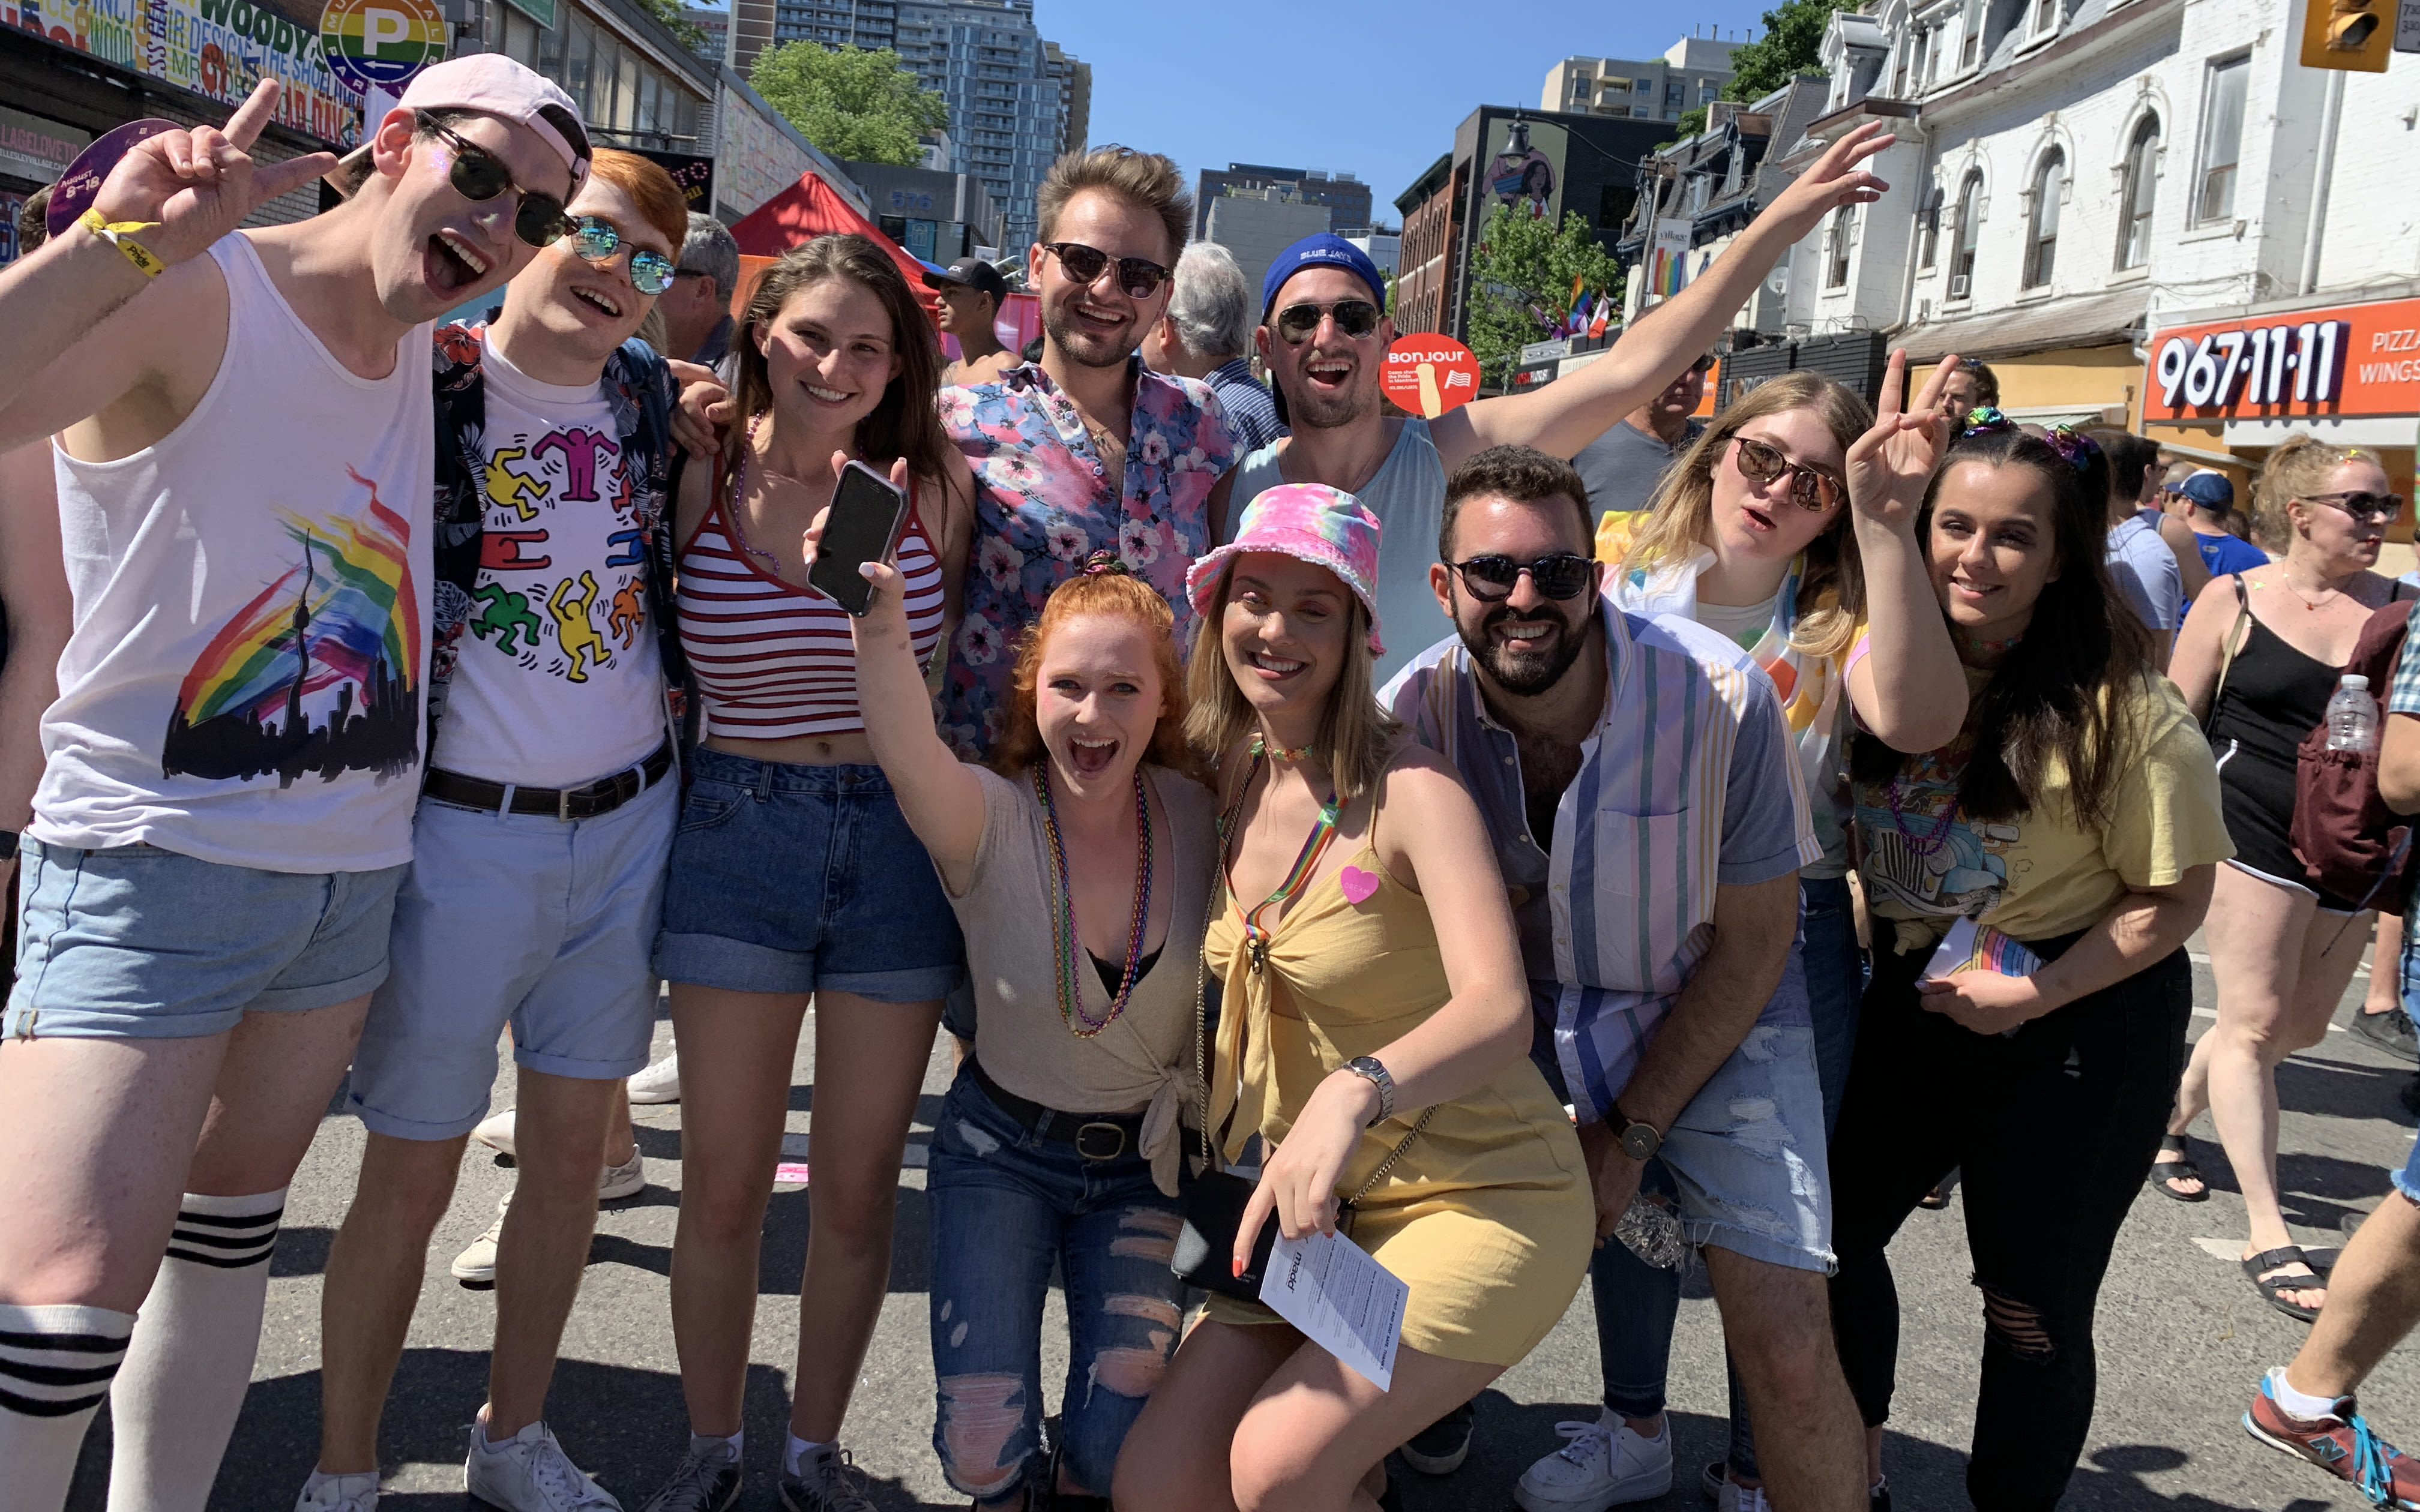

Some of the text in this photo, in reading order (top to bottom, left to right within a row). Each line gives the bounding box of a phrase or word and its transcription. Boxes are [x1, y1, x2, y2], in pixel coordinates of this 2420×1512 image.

[363, 7, 409, 55] P
[0, 124, 79, 163] LAGELOVETO
[892, 191, 932, 209] 576
[1301, 249, 1326, 260] BLUE
